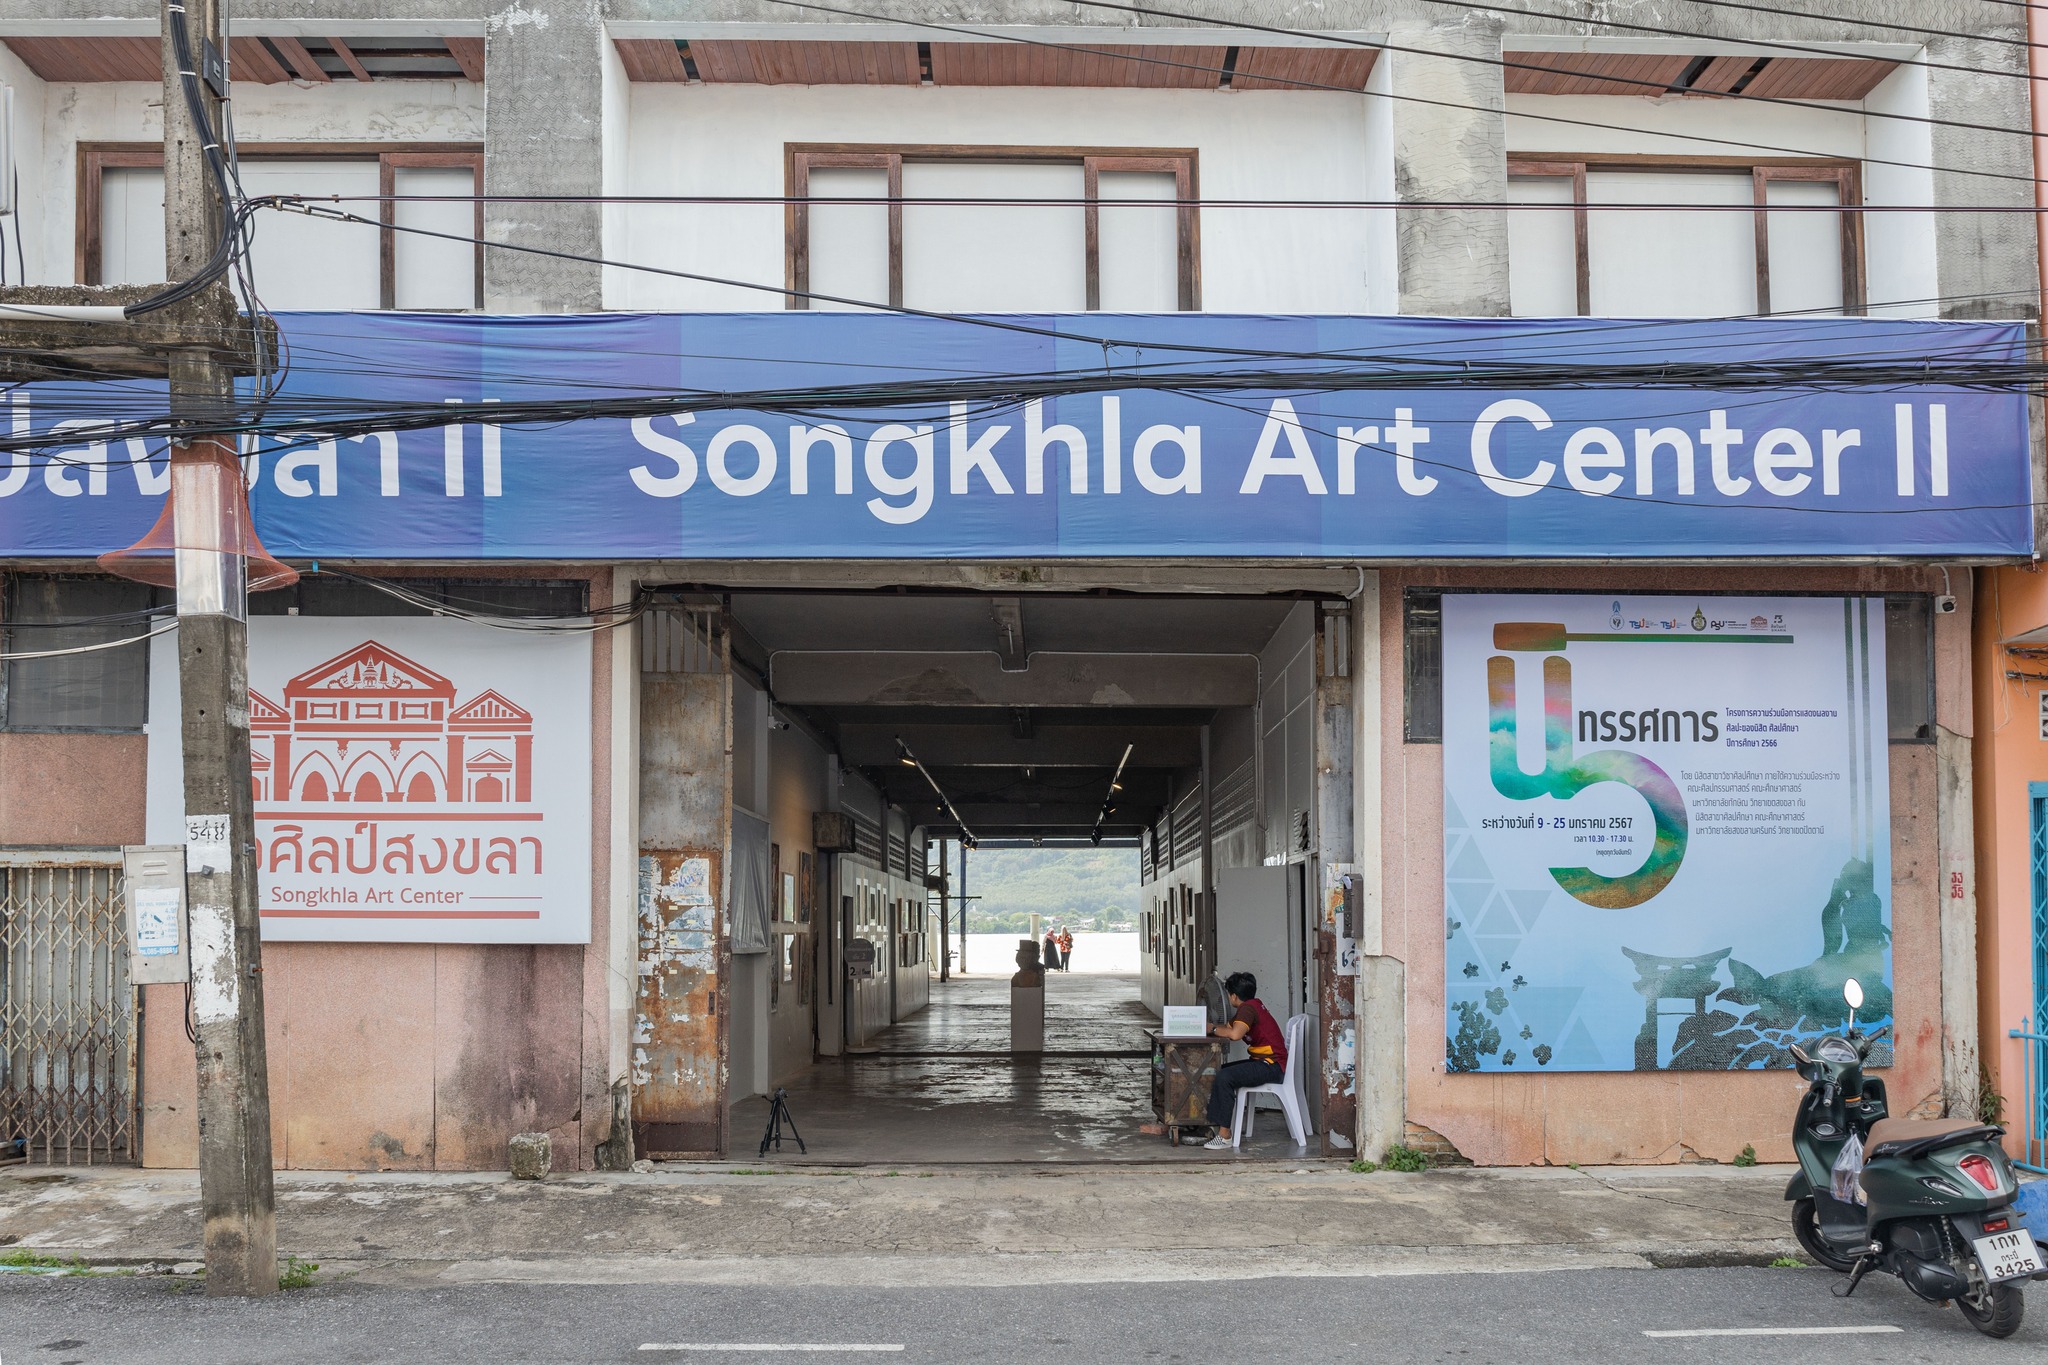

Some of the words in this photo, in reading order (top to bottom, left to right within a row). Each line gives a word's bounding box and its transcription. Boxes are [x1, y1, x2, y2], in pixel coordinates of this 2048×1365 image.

[630, 395, 1202, 525] Songkhla
[1240, 397, 1437, 497] Art
[1470, 398, 1861, 498] Center
[1895, 403, 1949, 497] II
[1725, 737, 1760, 748] ปีการศึกษา
[1761, 738, 1778, 748] 2566
[1680, 770, 1692, 780] โดย
[1796, 798, 1806, 807] กับ
[1481, 813, 1535, 829] ระหว่างวันที่
[1537, 817, 1544, 829] 9
[1553, 817, 1566, 829] 25
[1568, 817, 1606, 829] มกราคม
[1608, 817, 1633, 829] 2567
[1573, 835, 1587, 843] เวลา
[1588, 834, 1605, 843] 10.30
[1610, 834, 1627, 843] 17.30
[254, 821, 543, 876] ศิลป์สงขลา
[1951, 871, 1964, 884] 33
[271, 886, 359, 908] Songkhla
[364, 887, 394, 904] Art
[402, 887, 464, 904] Center
[1951, 886, 1964, 899] 35
[1988, 1233, 2021, 1251] 1กท
[2000, 1248, 2020, 1262] กระบี่
[1994, 1258, 2036, 1278] 3425
